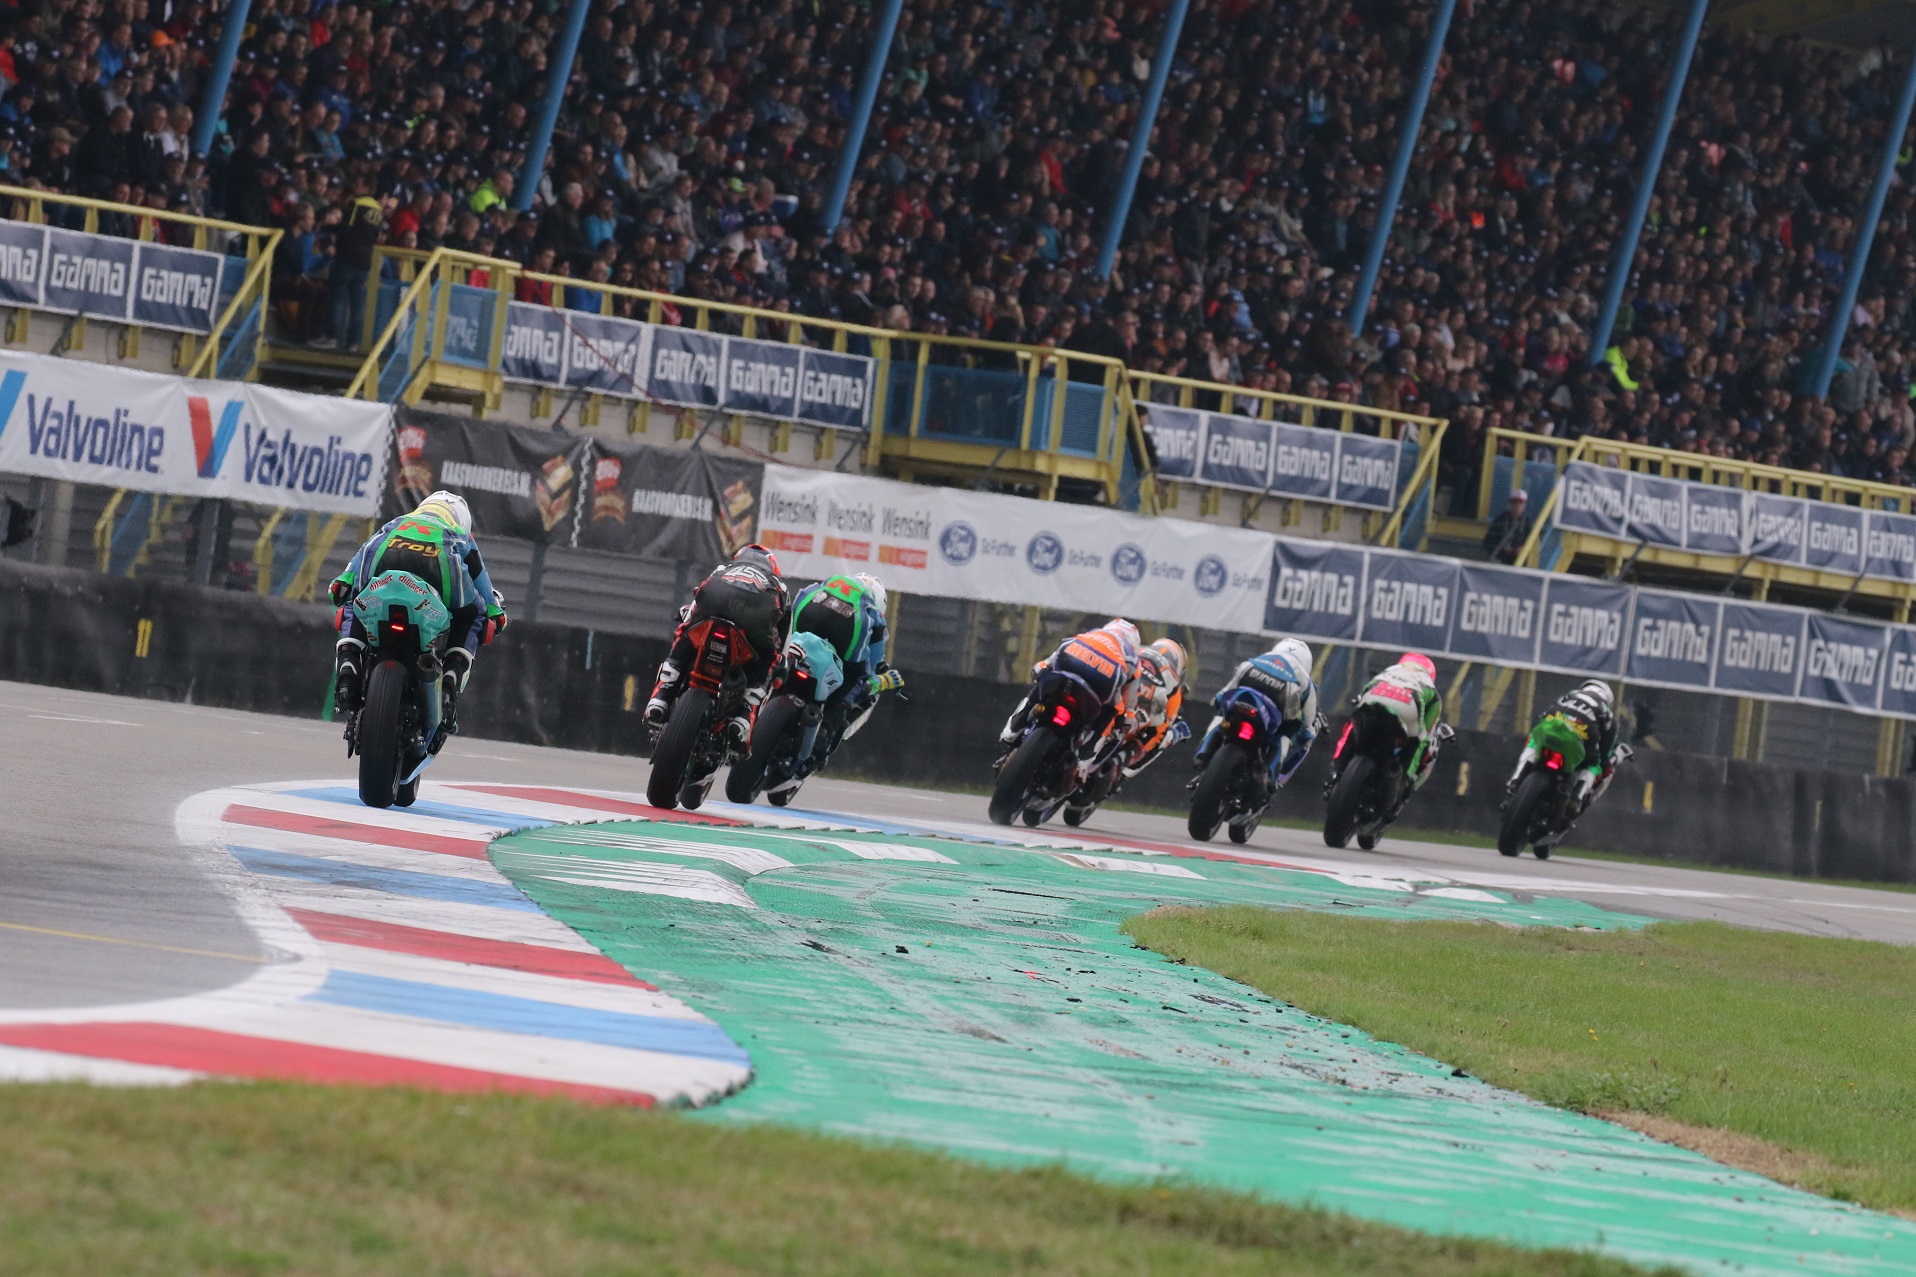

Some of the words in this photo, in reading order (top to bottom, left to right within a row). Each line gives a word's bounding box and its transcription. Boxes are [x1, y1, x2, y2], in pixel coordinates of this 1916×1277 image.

[27, 393, 164, 475] Valvoline
[243, 422, 373, 498] Valvoline
[388, 538, 441, 558] Troy
[370, 574, 393, 591] dillinger
[399, 575, 427, 595] dillinger
[1064, 642, 1116, 678] MELVIN
